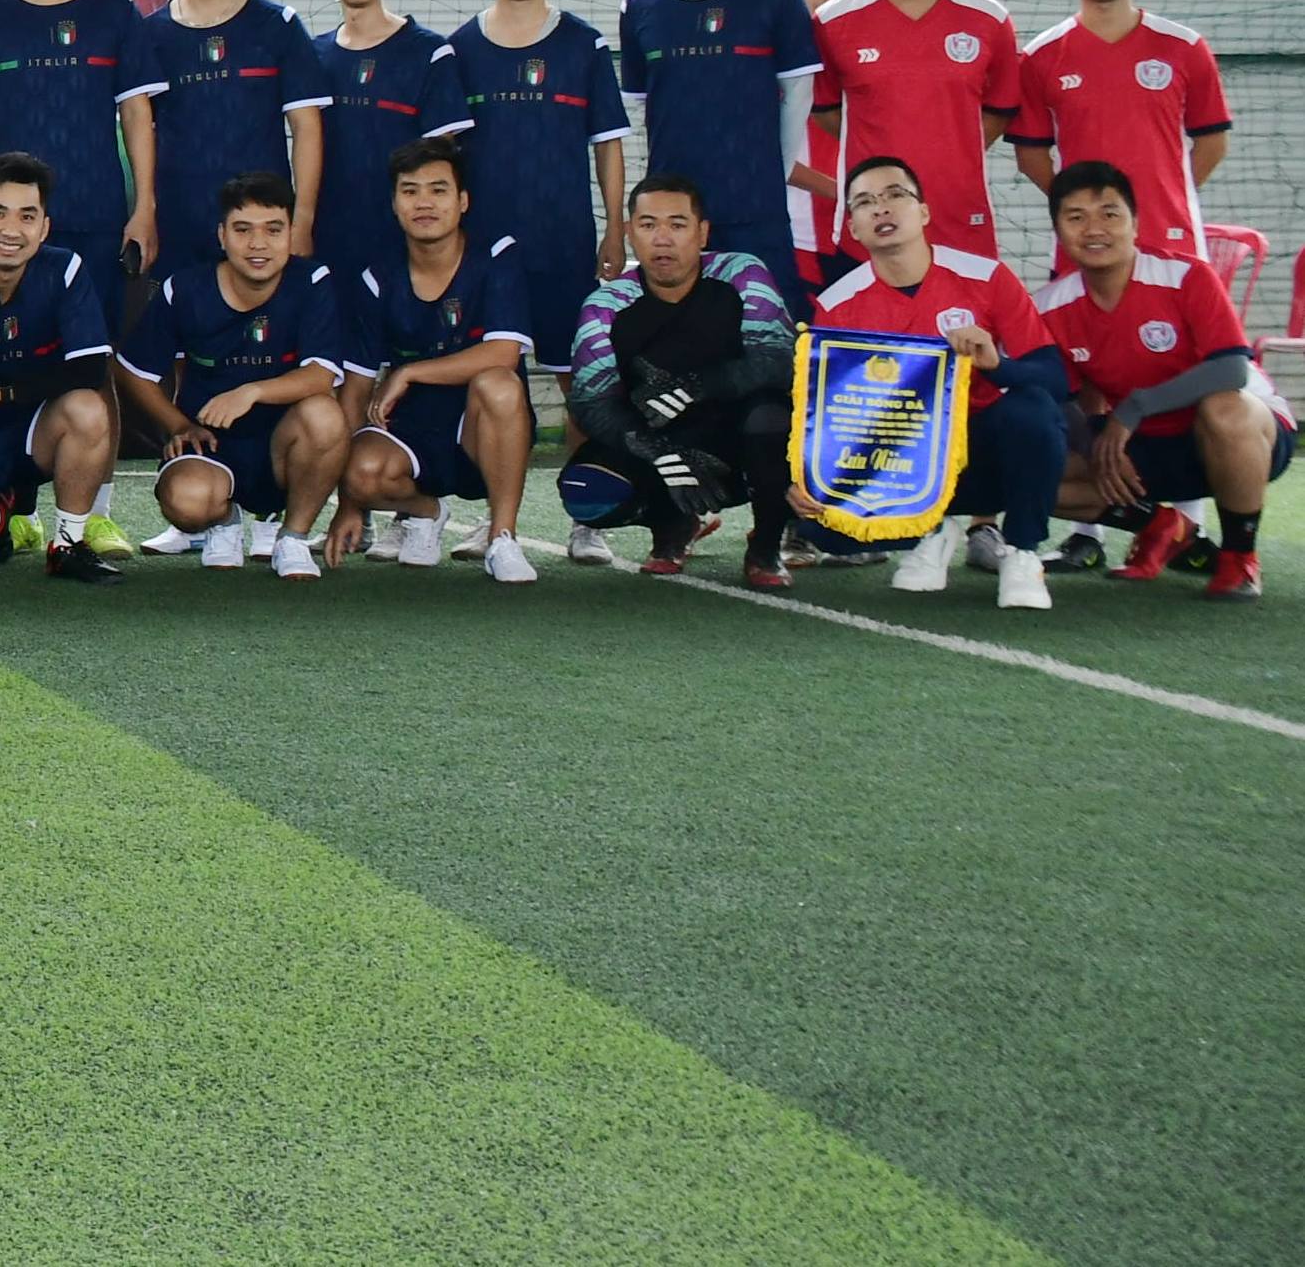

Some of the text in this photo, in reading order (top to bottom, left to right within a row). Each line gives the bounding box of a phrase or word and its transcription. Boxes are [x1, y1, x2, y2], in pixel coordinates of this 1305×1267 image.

[672, 45, 723, 57] ITALIA
[28, 57, 78, 68] ITALIA
[179, 69, 229, 85] ITALIA
[492, 91, 544, 103] ITALIA
[225, 355, 272, 367] ITALIA
